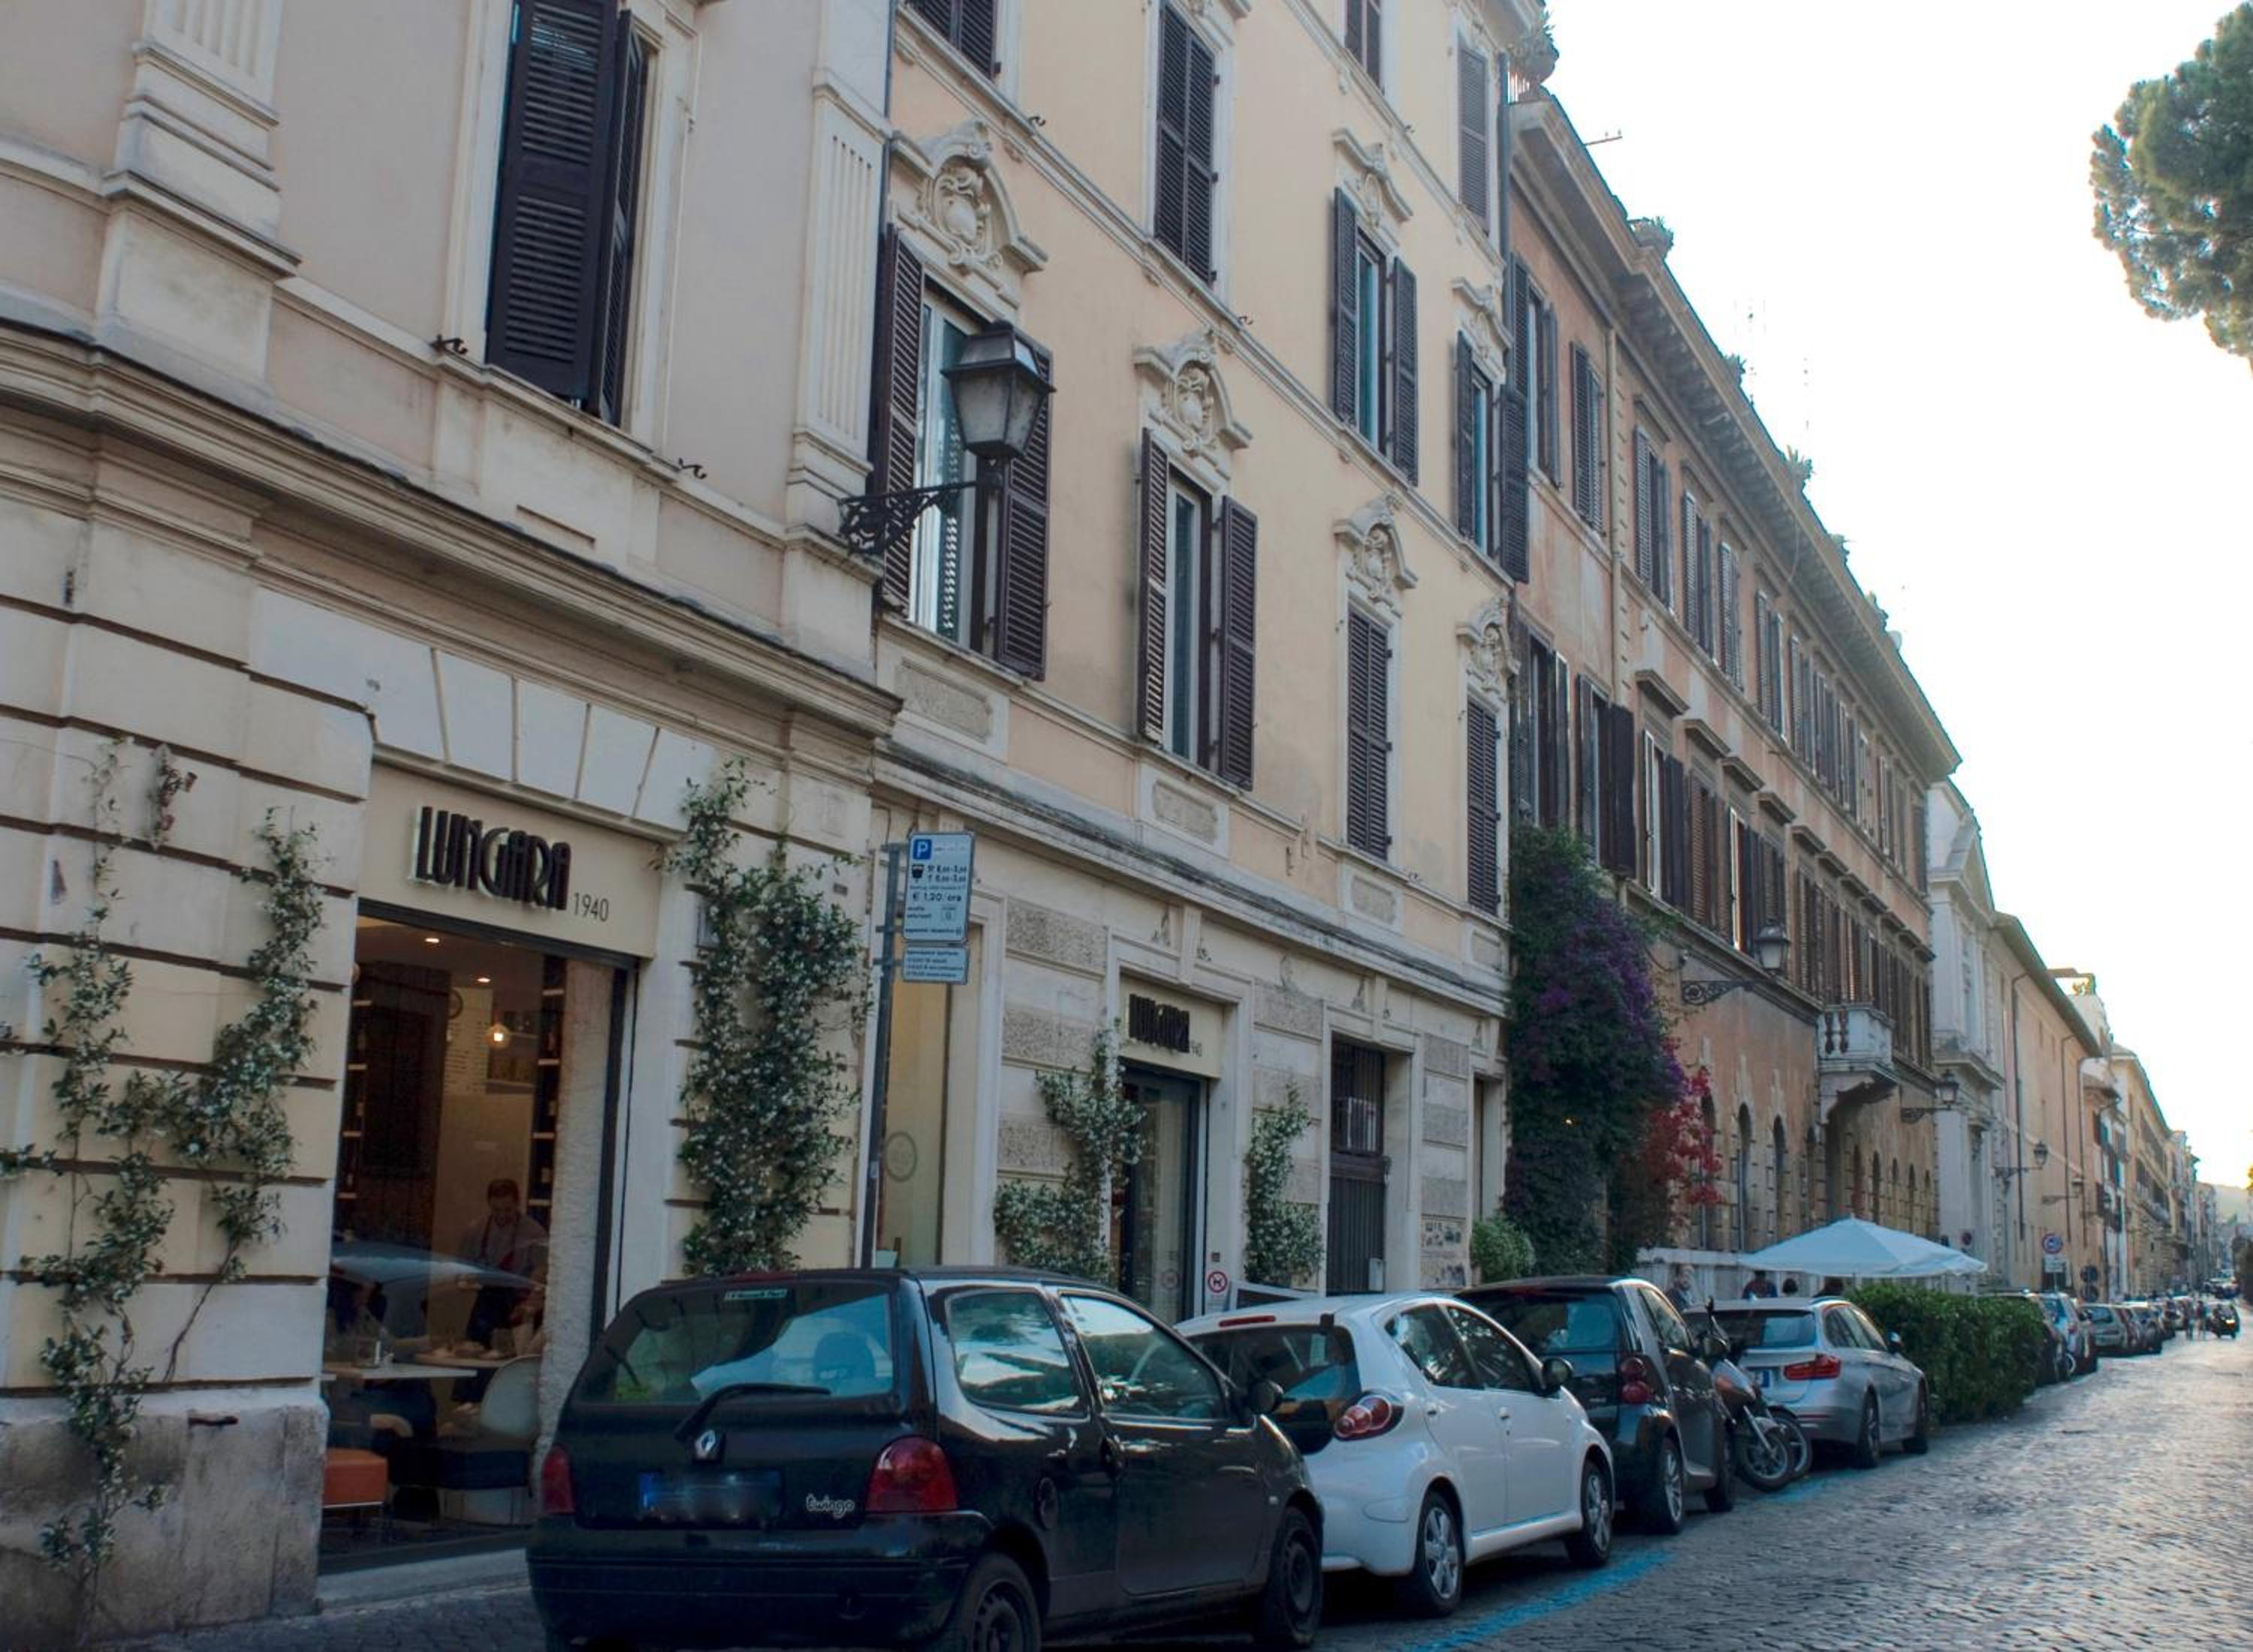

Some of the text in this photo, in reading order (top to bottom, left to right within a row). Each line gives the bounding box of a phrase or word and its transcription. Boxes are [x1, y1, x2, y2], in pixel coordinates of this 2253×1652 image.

[916, 840, 930, 858] P
[573, 891, 609, 922] 1940
[805, 1493, 855, 1520] twingo
